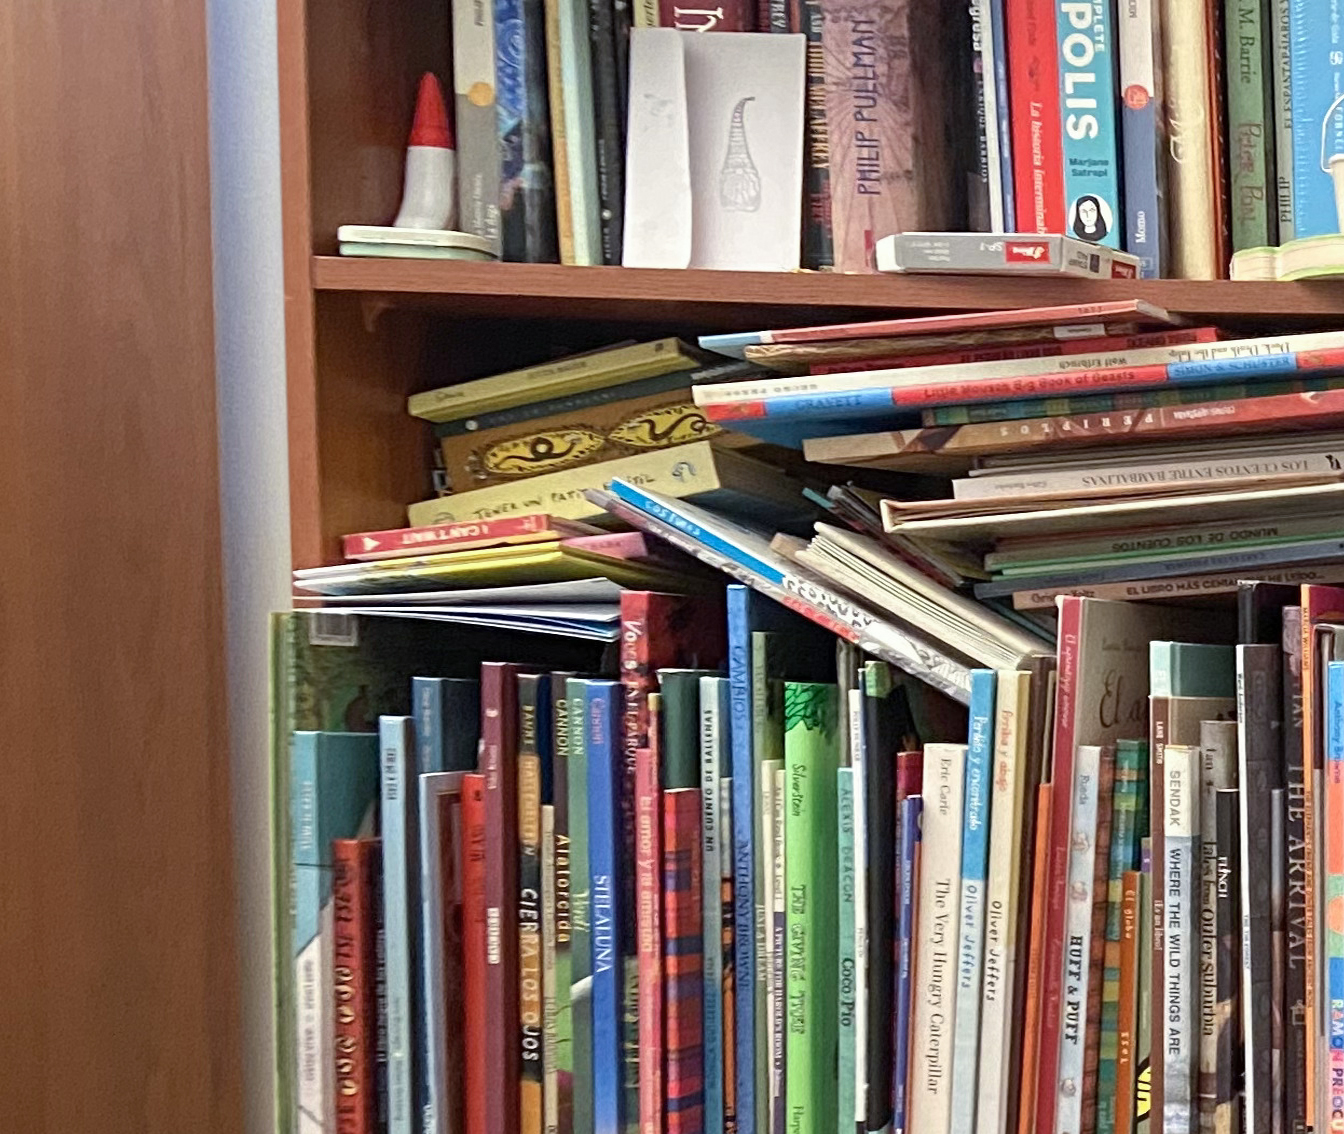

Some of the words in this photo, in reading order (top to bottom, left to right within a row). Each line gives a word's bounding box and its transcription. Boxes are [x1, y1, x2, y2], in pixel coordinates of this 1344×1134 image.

[1238, 8, 1253, 33] M.
[850, 18, 878, 122] PULLMAN
[1060, 2, 1097, 140] POLIS
[1238, 35, 1255, 84] Barrie
[1030, 101, 1043, 117] La
[854, 130, 881, 195] PHILIP
[1030, 120, 1043, 165] historia
[1069, 157, 1110, 170] Marjane
[1071, 168, 1108, 179] Satrapi
[1134, 210, 1146, 243] Momo
[998, 413, 1152, 437] PERIPLOS
[1080, 468, 1164, 486] BAMBALINAS
[1167, 465, 1212, 480] ENTRE
[1214, 461, 1278, 478] CUENTOS
[1280, 457, 1309, 473] LOS
[401, 528, 435, 545] WAIT
[1111, 536, 1170, 552] CUENTOS
[1173, 532, 1201, 547] LOS
[1205, 529, 1224, 543] DE
[1229, 524, 1278, 540] MUNDO
[731, 644, 748, 720] CAMBIOS
[555, 698, 567, 755] CANNON
[571, 697, 583, 755] CANNON
[970, 715, 988, 751] Perdido
[936, 758, 951, 784] Eric
[1286, 763, 1306, 823] THE
[935, 787, 951, 815] Carle
[967, 764, 983, 831] encontrado
[1168, 769, 1180, 826] SENDAK
[553, 834, 571, 943] Alatorcida
[735, 839, 749, 915] ANTHONY
[930, 877, 949, 907] The
[1167, 847, 1181, 897] WHERE
[593, 874, 612, 972] STELALUNA
[962, 883, 978, 927] Oliver
[986, 900, 1002, 943] Oliver
[1167, 900, 1181, 929] THE
[1286, 833, 1306, 969] ARRIVAL
[518, 888, 538, 959] CIERRA
[927, 911, 948, 946] Very
[1199, 907, 1216, 959] Outer
[735, 918, 749, 989] BROWNE
[958, 933, 975, 988] Jeffers
[1066, 934, 1084, 980] HUFF
[1167, 933, 1181, 969] WILD
[519, 966, 537, 1018] LOS
[838, 957, 855, 996] Coco
[925, 951, 946, 1007] Hungry
[983, 947, 1000, 1001] Jeffers
[838, 999, 856, 1027] Pío
[1167, 971, 1181, 1024] THINGS
[1199, 961, 1216, 1036] suburbia
[519, 1024, 538, 1061] OJOS
[1063, 1000, 1080, 1045] PUFF
[1167, 1027, 1181, 1055] ARE
[922, 1012, 944, 1095] Caterpillar
